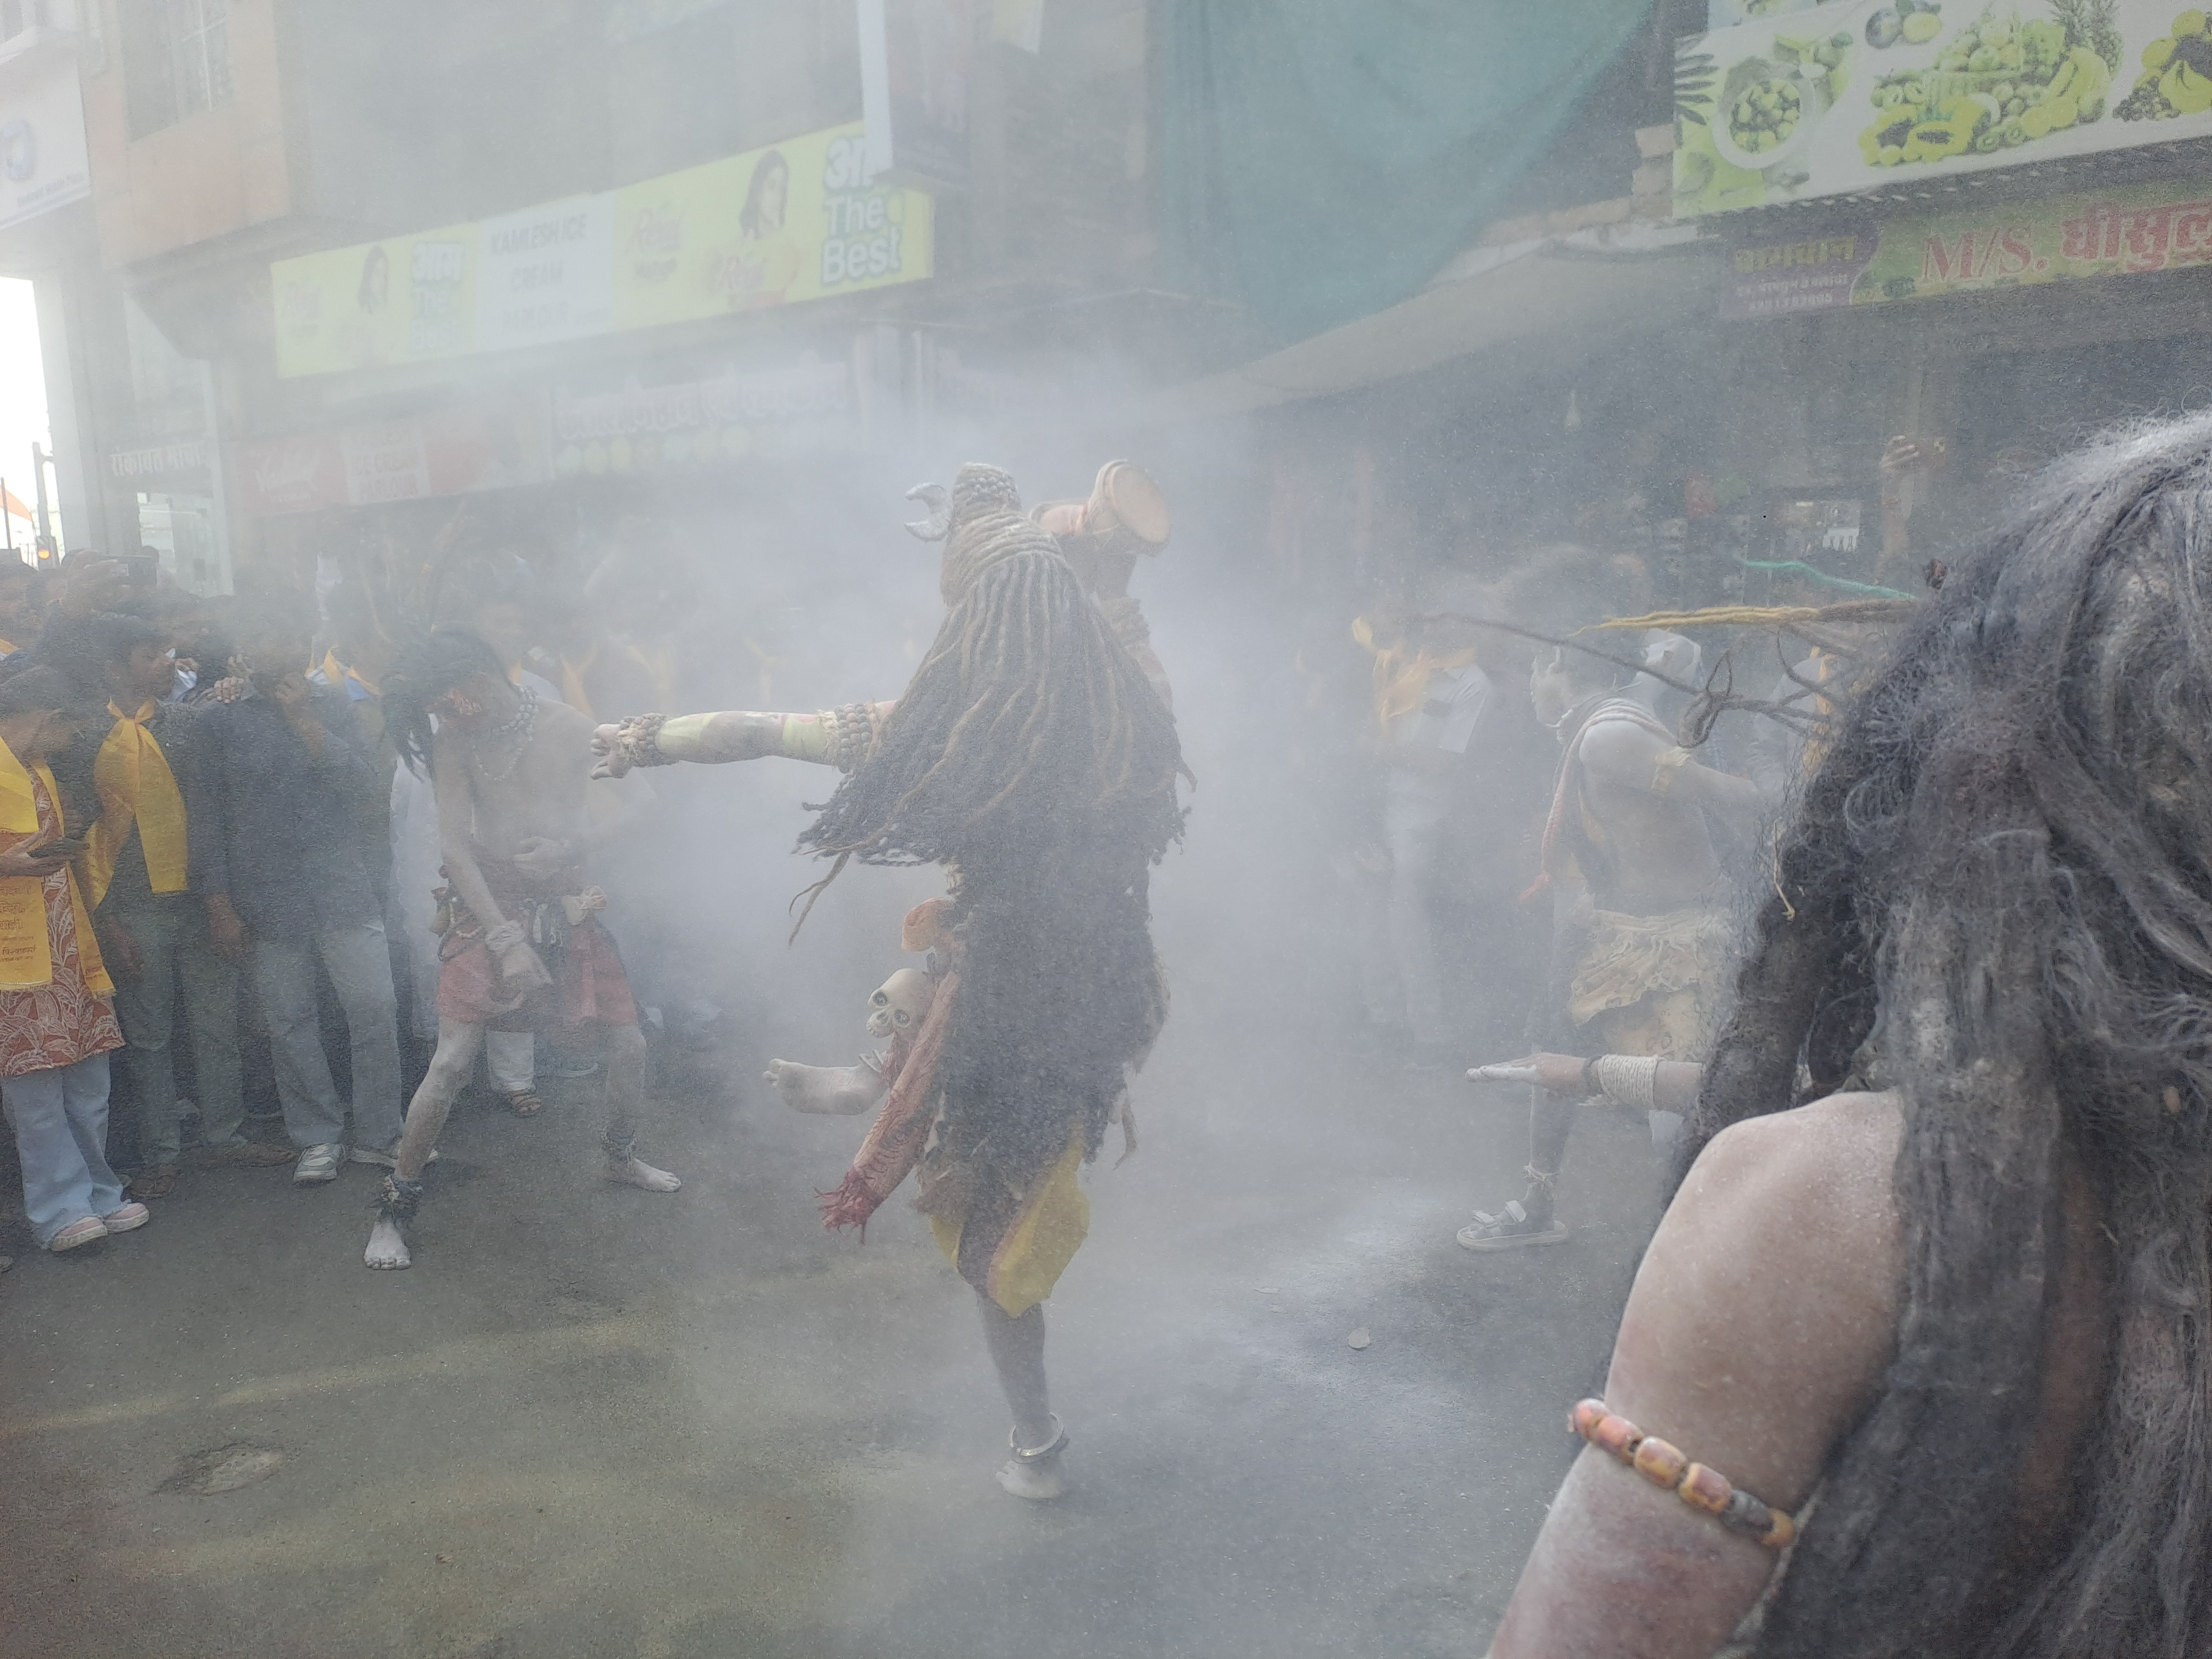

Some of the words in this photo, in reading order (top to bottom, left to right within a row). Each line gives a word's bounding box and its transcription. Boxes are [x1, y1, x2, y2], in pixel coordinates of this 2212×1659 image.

[561, 213, 587, 241] ICE
[823, 196, 884, 236] The
[823, 226, 900, 284] Best
[1921, 222, 2048, 283] M/S.
[510, 260, 565, 293] CREAM
[412, 287, 448, 316] The
[412, 314, 457, 352] Best
